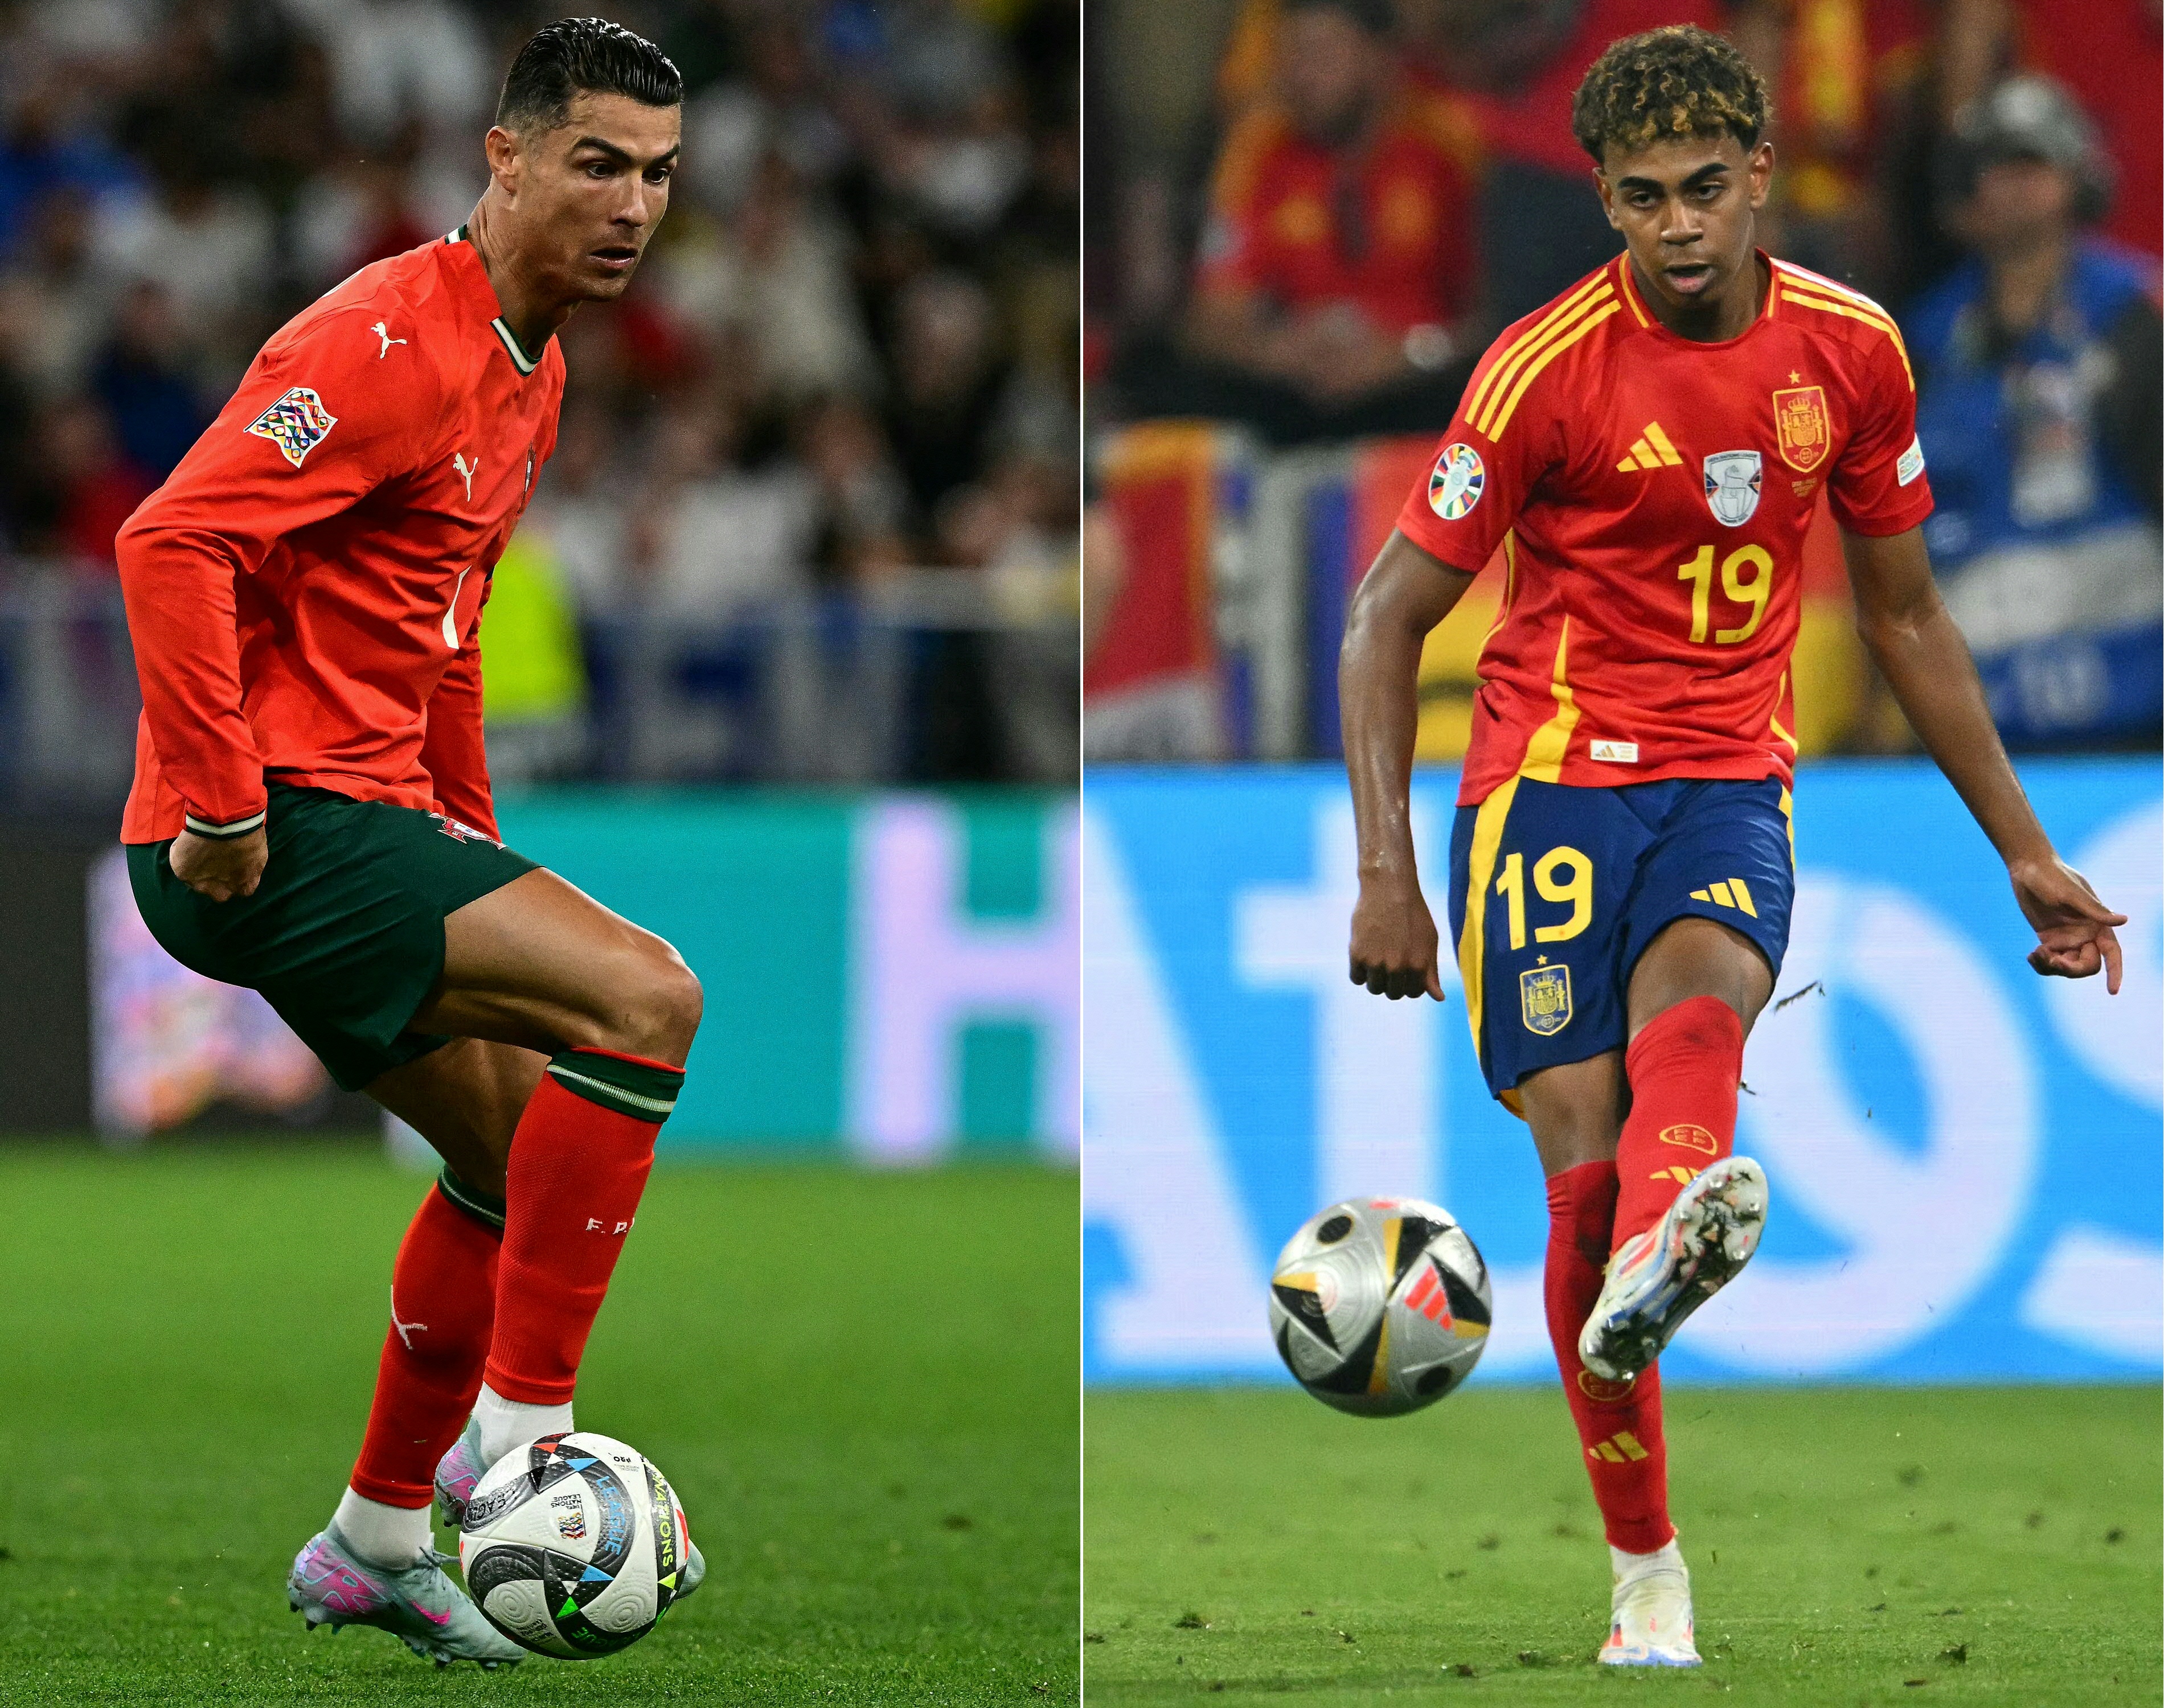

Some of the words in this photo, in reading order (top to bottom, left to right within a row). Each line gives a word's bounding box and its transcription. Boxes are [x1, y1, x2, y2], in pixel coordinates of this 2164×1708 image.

[1678, 544, 1773, 643] 19
[1496, 845, 1593, 950] 19
[551, 1493, 581, 1502] LEAGUE
[551, 1499, 582, 1508] NATIONS
[596, 1476, 625, 1555] LEAGUE
[652, 1472, 673, 1567] NATIONS
